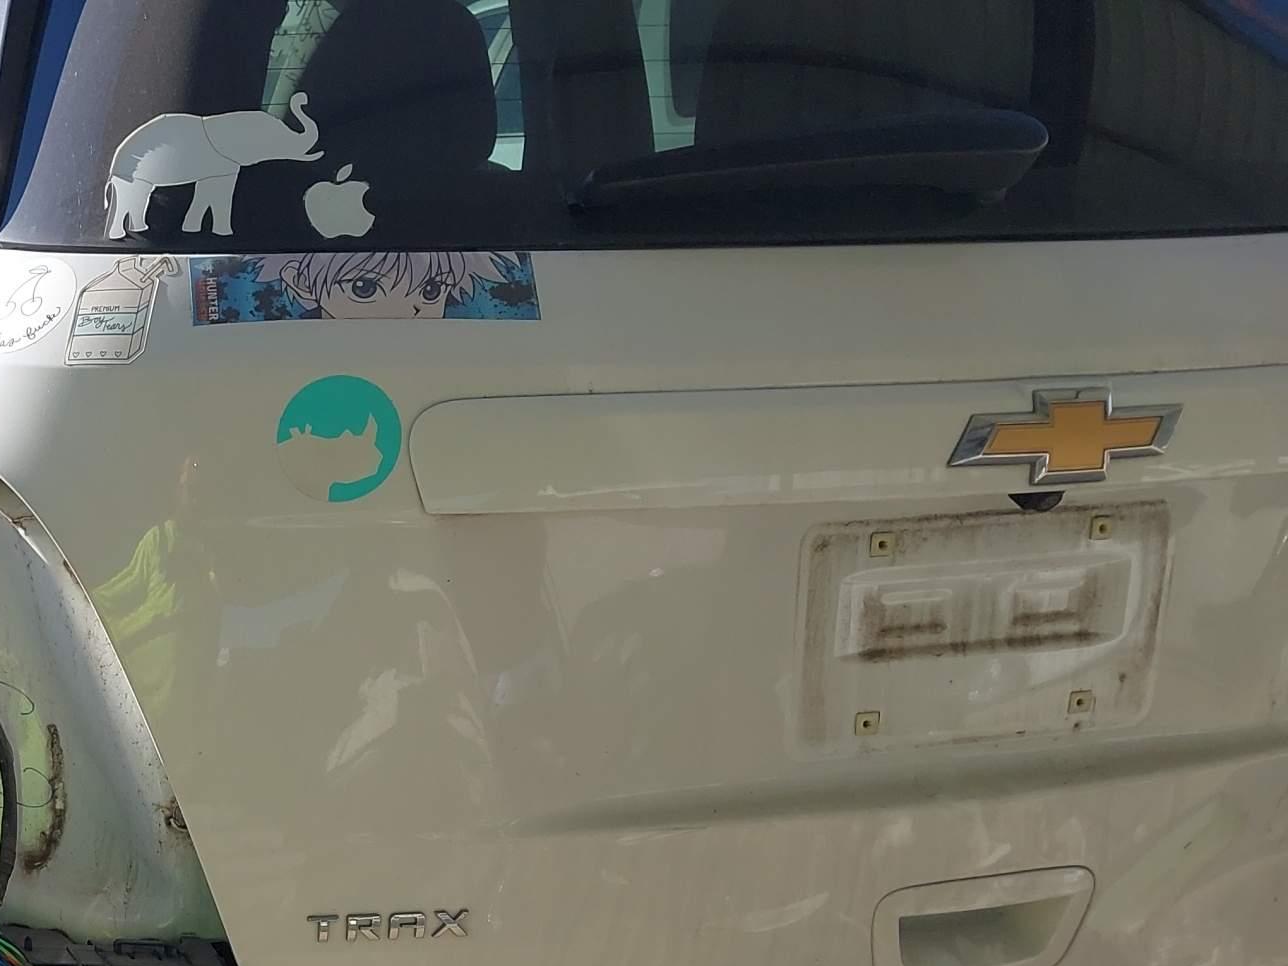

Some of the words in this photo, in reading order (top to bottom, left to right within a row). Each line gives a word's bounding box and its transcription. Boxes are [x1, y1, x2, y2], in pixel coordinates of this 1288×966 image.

[90, 305, 120, 313] PREMIUM
[206, 277, 220, 321] HUNTER
[306, 908, 470, 943] TRAX
